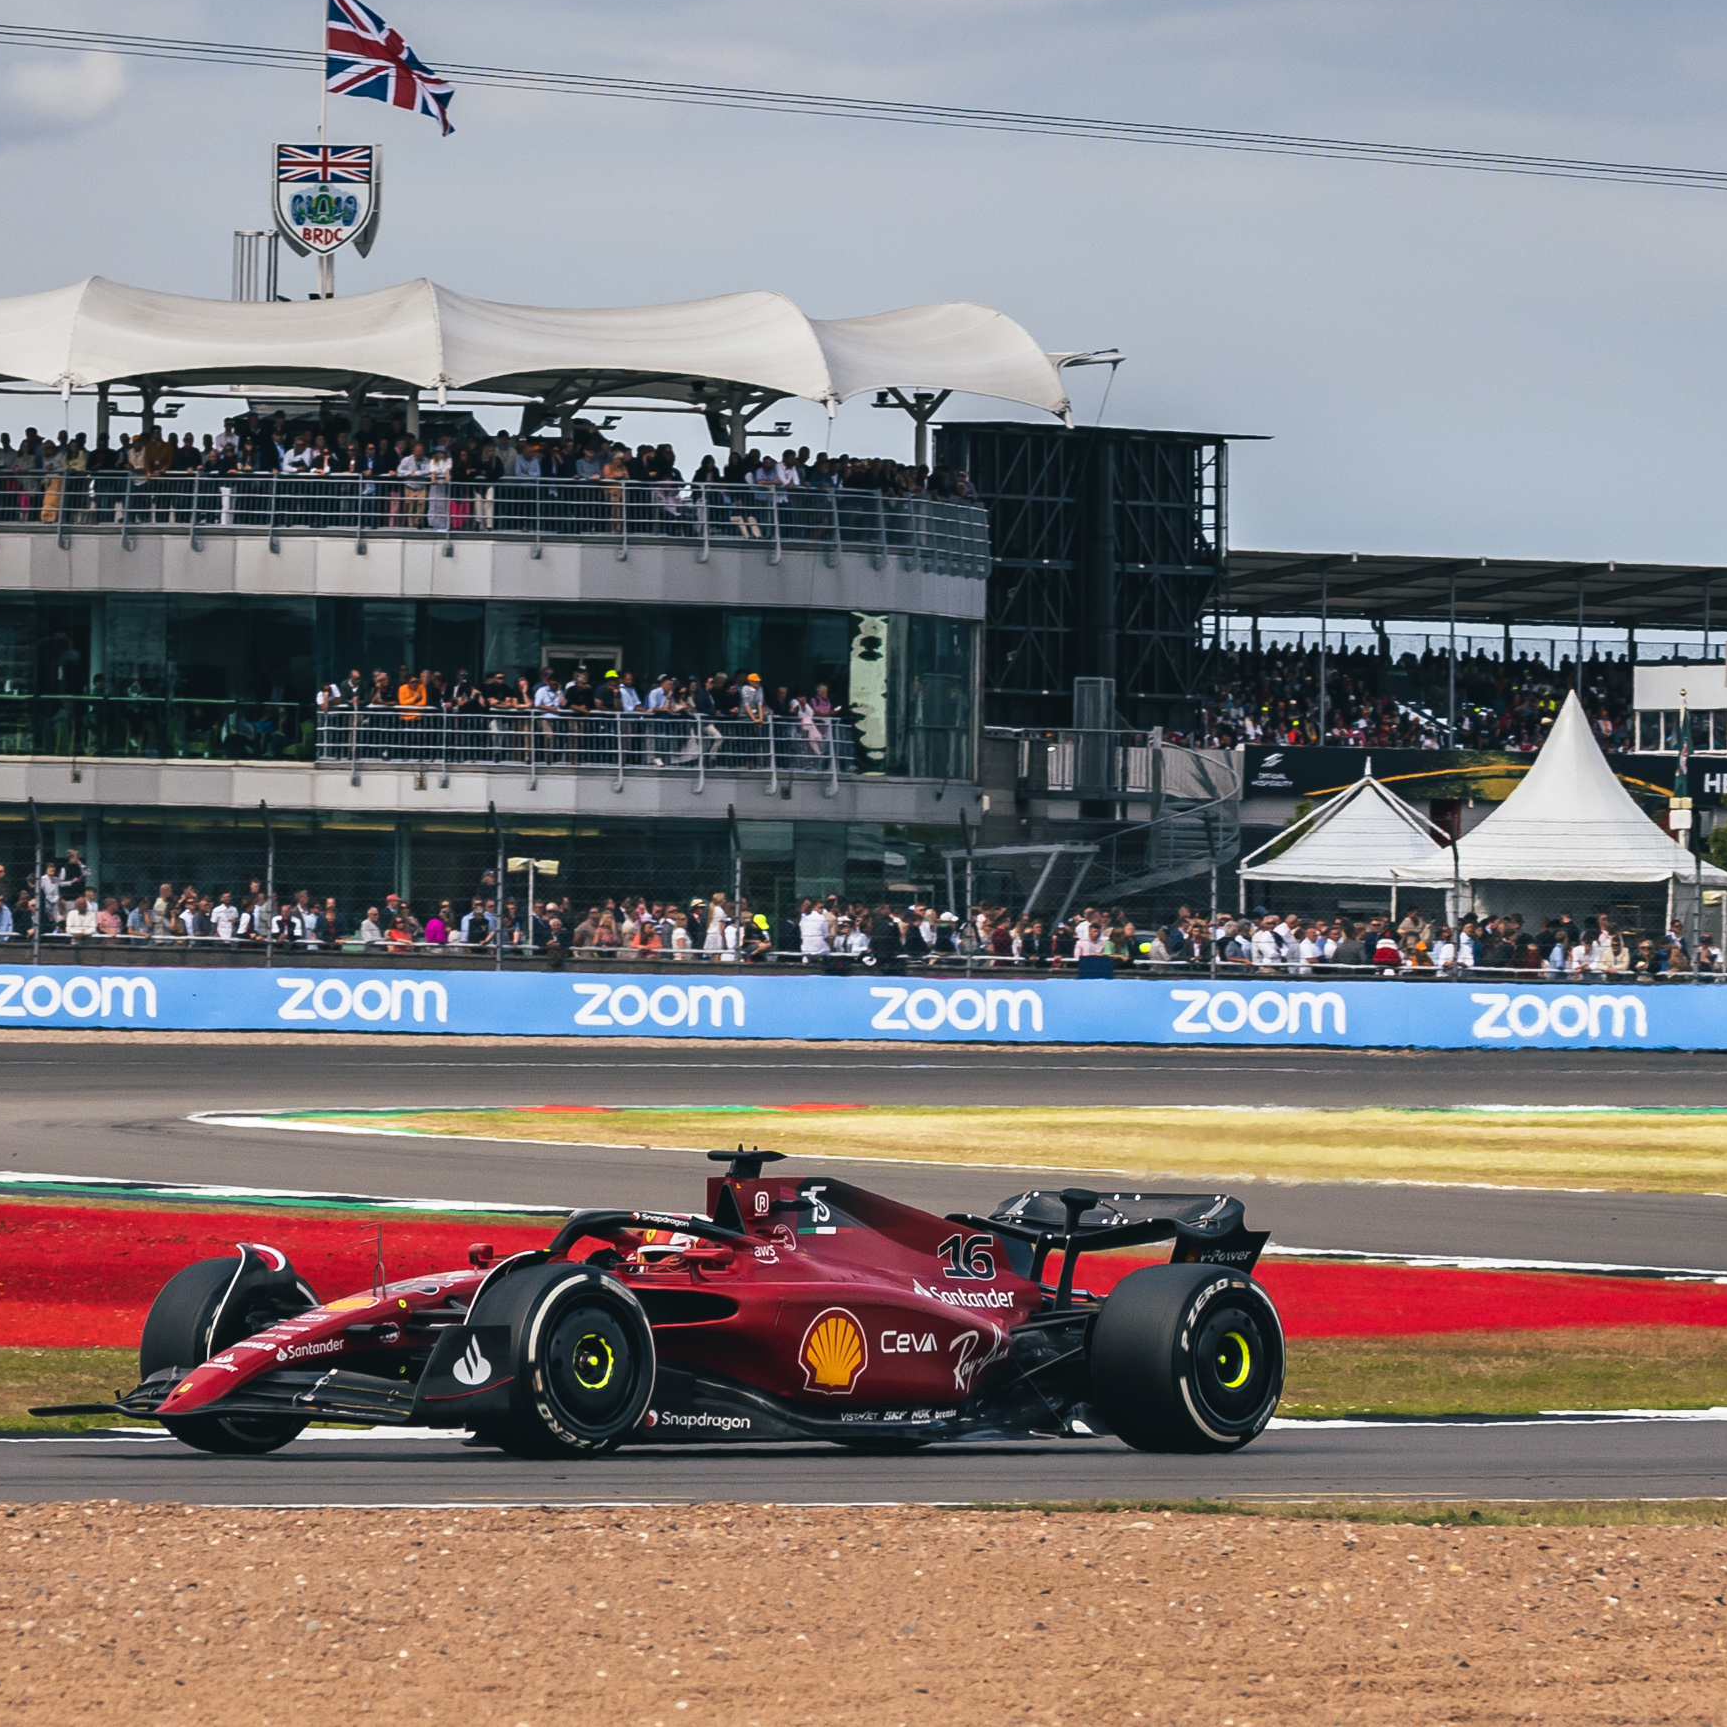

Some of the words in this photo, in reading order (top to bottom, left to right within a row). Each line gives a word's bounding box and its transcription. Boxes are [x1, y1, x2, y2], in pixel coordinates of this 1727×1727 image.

[303, 227, 343, 246] BRDC
[277, 978, 447, 1022] zoom
[573, 984, 744, 1026] zoom
[870, 987, 1043, 1031] zoom
[1171, 990, 1345, 1034] zoom
[1471, 993, 1647, 1038] zoom
[641, 1213, 690, 1228] Snapdragon
[754, 1244, 776, 1258] aws
[937, 1233, 997, 1282] 16
[1199, 1248, 1252, 1264] V-Power
[928, 1286, 1015, 1308] Santander
[1186, 1277, 1229, 1330] ZERO
[287, 1338, 345, 1360] Santander
[661, 1411, 751, 1431] Snapdragon
